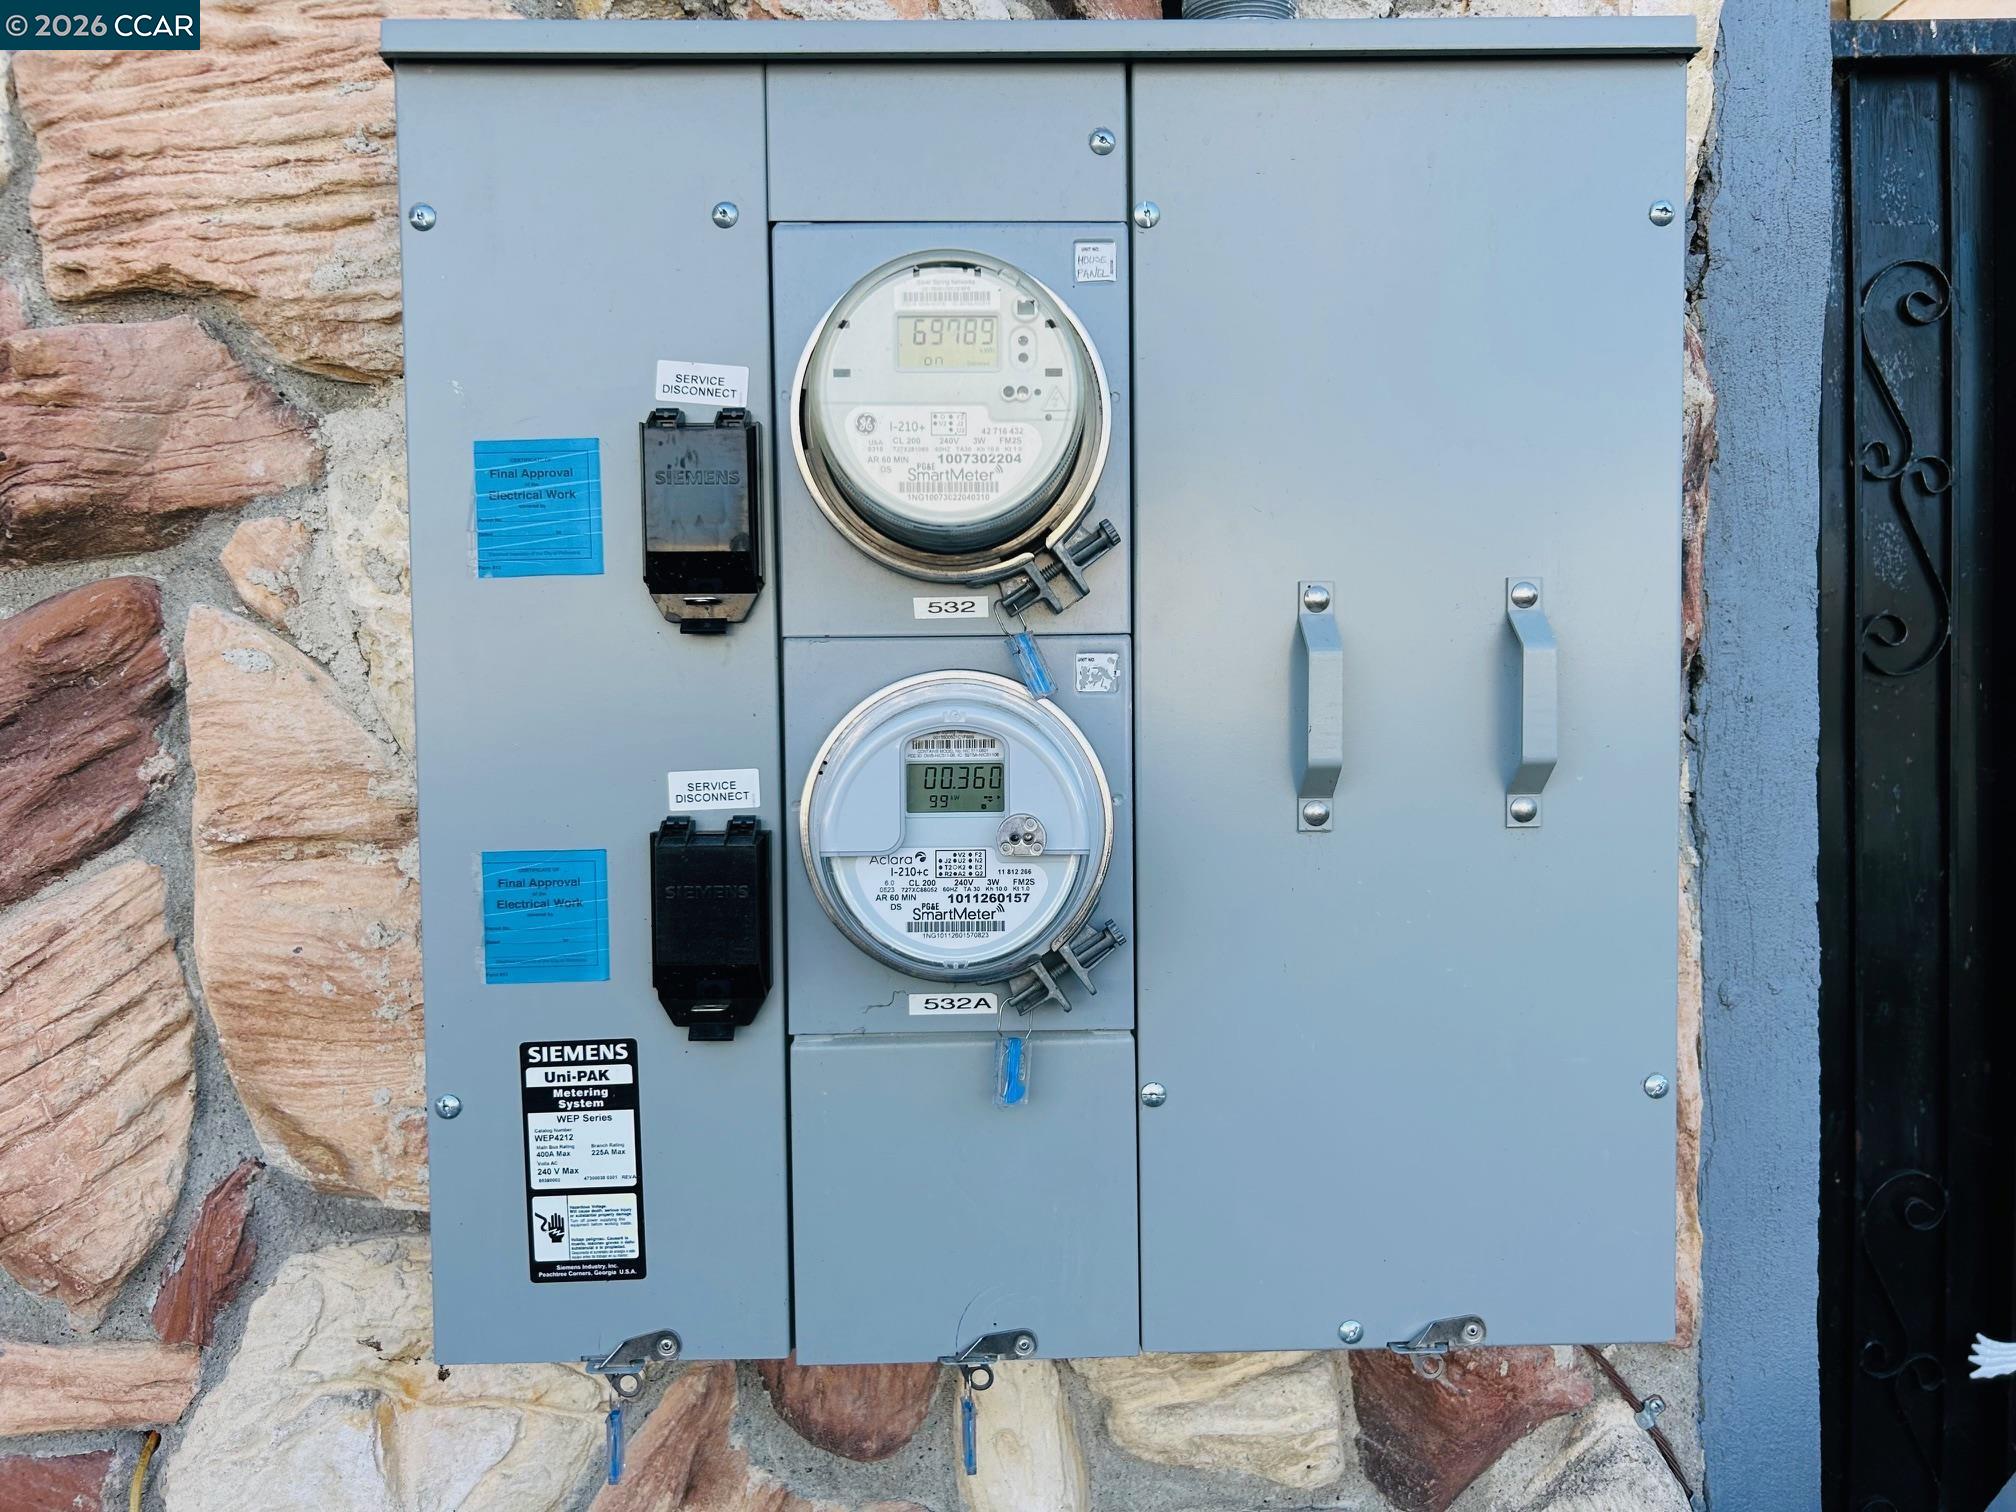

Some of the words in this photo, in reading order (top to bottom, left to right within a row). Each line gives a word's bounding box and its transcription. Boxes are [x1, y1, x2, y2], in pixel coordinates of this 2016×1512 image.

[1078, 256, 1107, 264] HOUSE
[913, 319, 994, 345] 69789
[675, 374, 725, 386] SERVICE
[662, 384, 737, 398] DISCONNECT
[890, 421, 925, 432] I-210+
[938, 454, 1022, 464] 1007302204
[489, 469, 517, 479] Final
[521, 468, 573, 480] Approval
[655, 470, 740, 485] SIEMENS
[908, 468, 994, 481] SmartMeter
[489, 491, 542, 500] Electrical
[546, 490, 576, 499] Work
[928, 601, 975, 613] 532
[924, 766, 1002, 789] 00.360
[687, 781, 736, 792] SERVICE
[676, 792, 750, 803] DISCONNECT
[930, 795, 948, 808] 99
[869, 855, 912, 865] Aclara
[891, 867, 928, 876] I-210+c
[497, 879, 525, 888] Final
[529, 877, 580, 889] Approval
[665, 884, 749, 899] SIEMENS
[496, 900, 549, 909] Electrical
[553, 898, 583, 908] Work
[948, 893, 1030, 903] 1011260157
[913, 908, 996, 920] SmartMeter
[924, 998, 991, 1010] 532A
[528, 1043, 629, 1063] SIEMENS
[544, 1070, 610, 1083] Uni-PAK
[553, 1088, 608, 1098] Metering
[558, 1100, 604, 1110] System
[557, 1115, 580, 1123] WEP
[583, 1114, 612, 1122] Series
[535, 1134, 574, 1142] WEP4212
